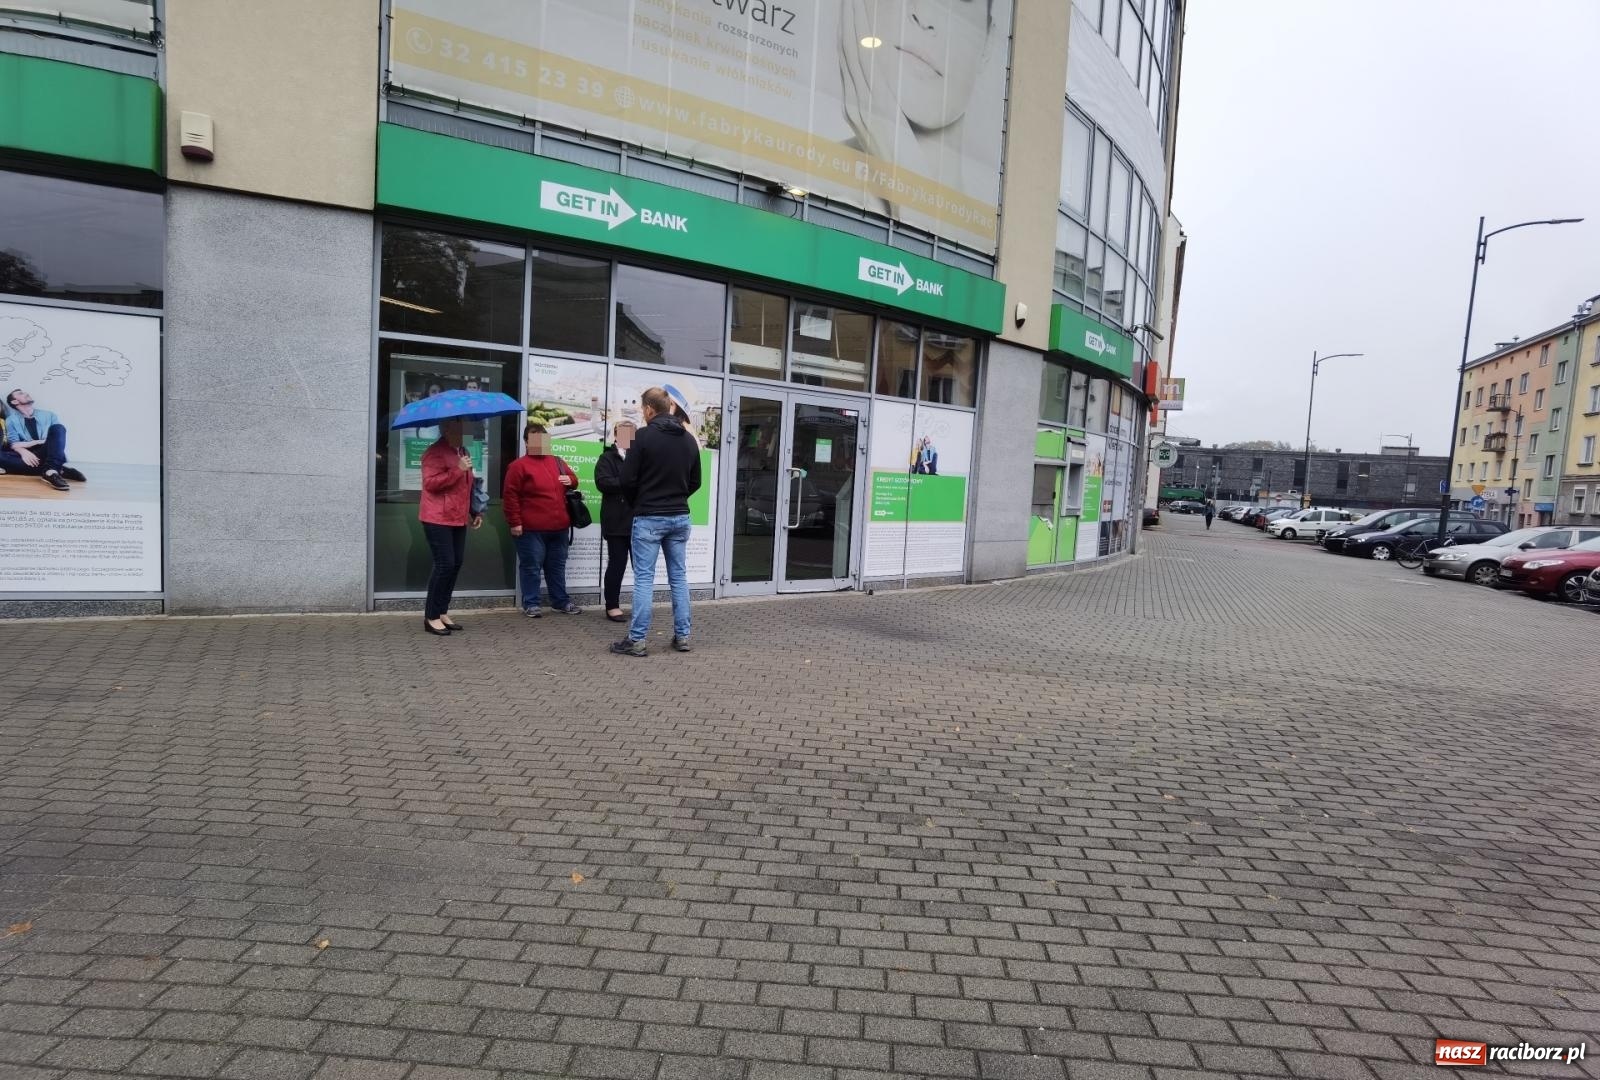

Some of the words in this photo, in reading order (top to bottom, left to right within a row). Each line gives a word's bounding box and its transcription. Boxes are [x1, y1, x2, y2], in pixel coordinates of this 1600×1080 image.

[717, 21, 799, 59] rozszerzonych
[440, 38, 471, 63] 32
[482, 52, 527, 78] 415
[539, 67, 566, 89] 23
[577, 77, 603, 98] 39
[556, 191, 595, 212] GET
[600, 200, 619, 217] IN
[640, 208, 688, 232] BANK
[868, 265, 891, 280] GET
[893, 272, 904, 285] IN
[916, 278, 943, 296] BANK
[551, 444, 577, 453] ONTO
